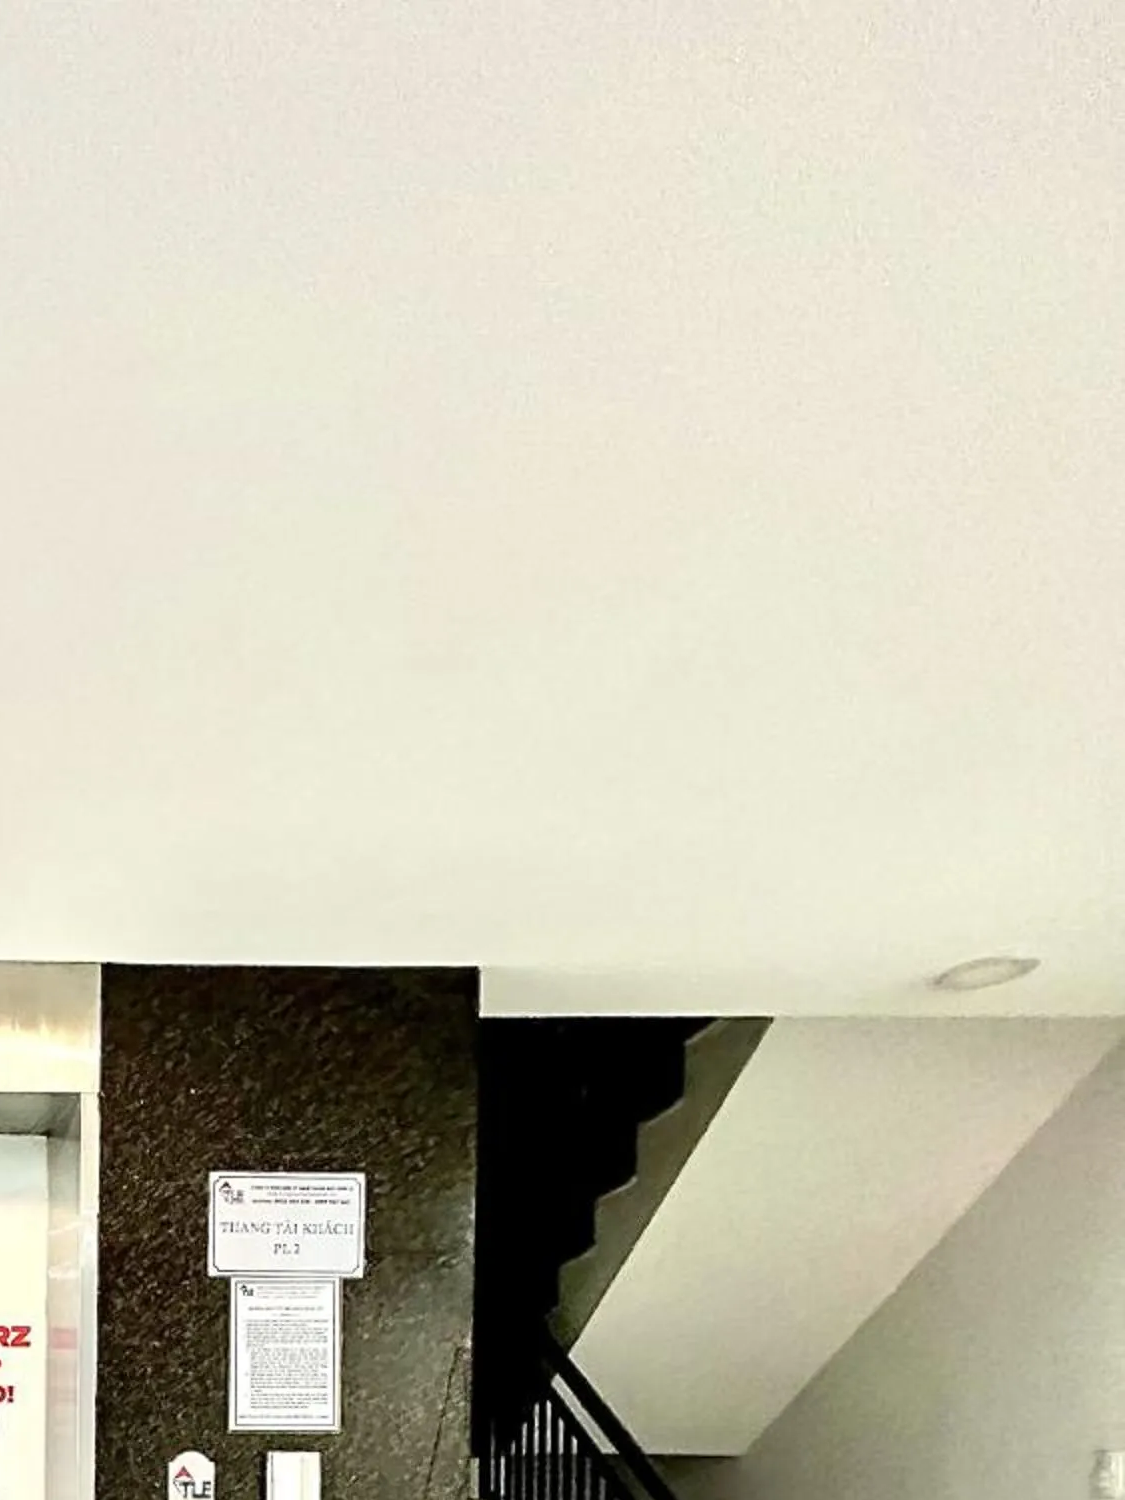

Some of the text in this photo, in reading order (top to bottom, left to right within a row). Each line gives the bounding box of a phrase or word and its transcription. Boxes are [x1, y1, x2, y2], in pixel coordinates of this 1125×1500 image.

[219, 1220, 270, 1234] THANG
[303, 1219, 354, 1235] KHÁCH
[294, 1243, 300, 1254] 2
[179, 1480, 212, 1499] TLE
